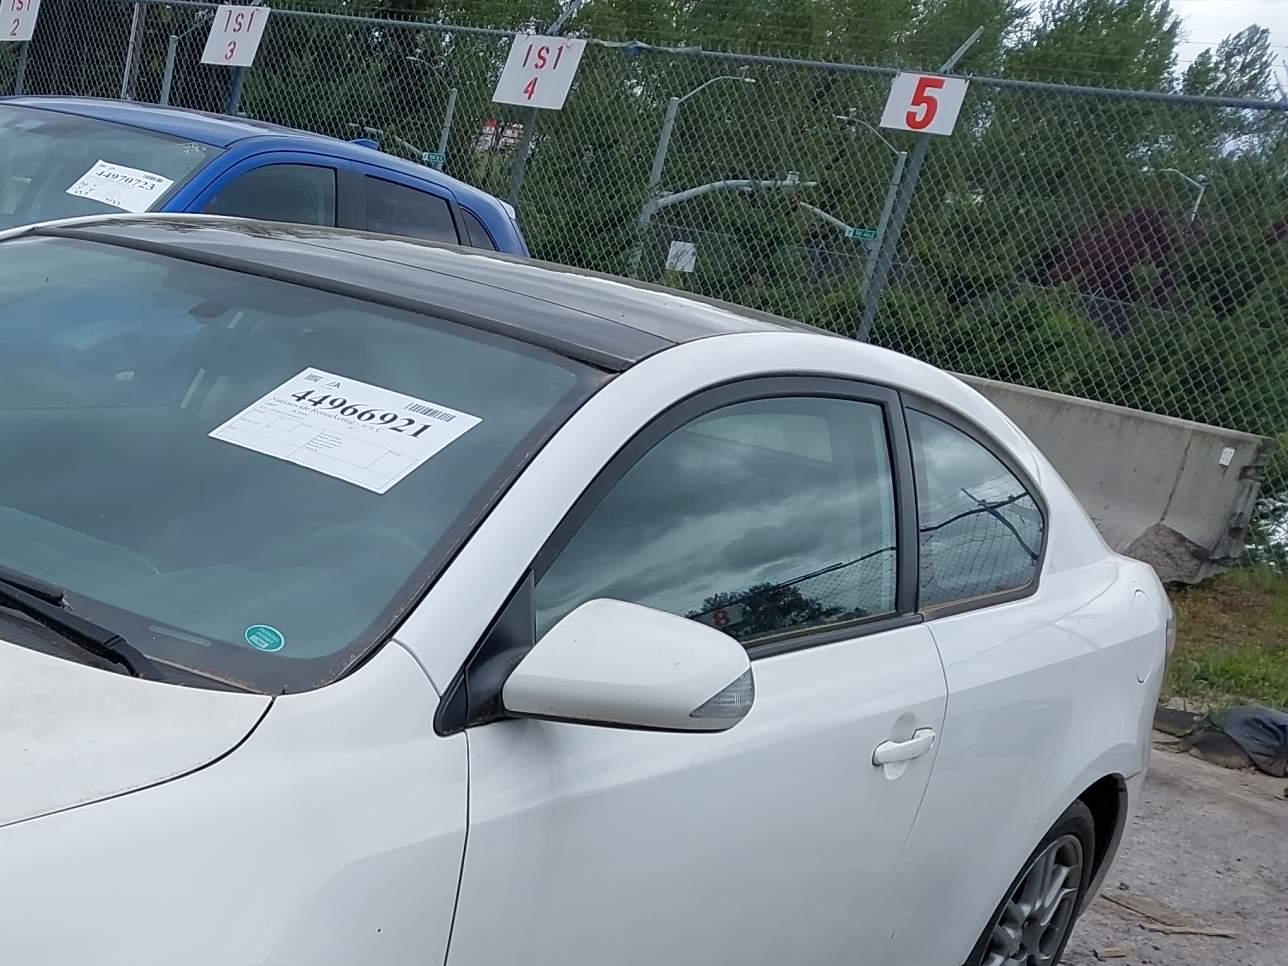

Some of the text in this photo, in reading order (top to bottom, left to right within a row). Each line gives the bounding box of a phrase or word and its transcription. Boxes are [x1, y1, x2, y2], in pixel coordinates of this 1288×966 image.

[10, 18, 20, 36] 2
[224, 40, 237, 61] 3
[523, 77, 538, 101] 4
[905, 76, 946, 130] 5
[95, 170, 156, 191] 44970723
[291, 389, 433, 439] 44966921
